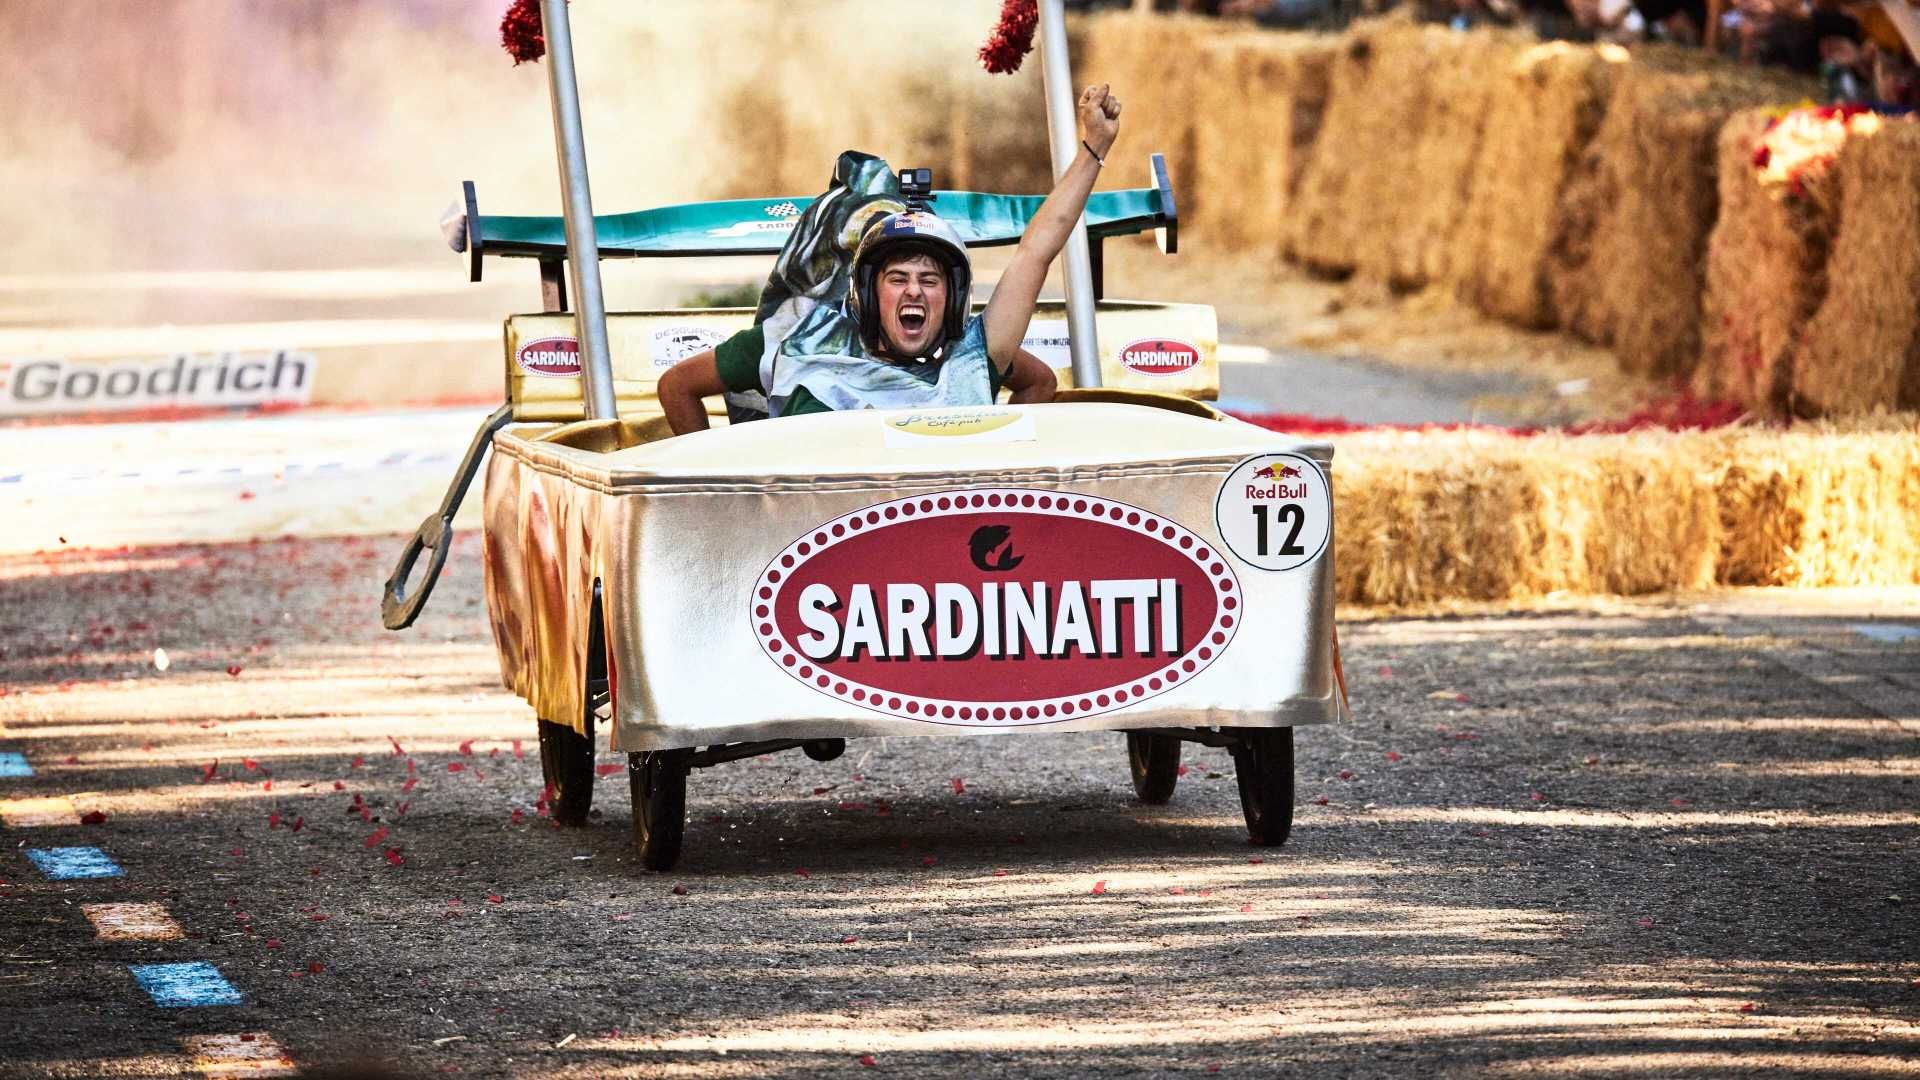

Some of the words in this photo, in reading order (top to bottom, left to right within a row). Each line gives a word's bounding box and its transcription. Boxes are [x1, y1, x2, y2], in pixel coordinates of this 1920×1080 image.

[0, 349, 307, 402] Goodrich
[524, 351, 580, 366] SARDINAT
[1125, 351, 1193, 367] SARDINATTI
[1246, 483, 1276, 499] Red
[1278, 483, 1307, 498] Bull
[1252, 503, 1305, 556] 12
[797, 578, 1181, 661] SARDINATTI
